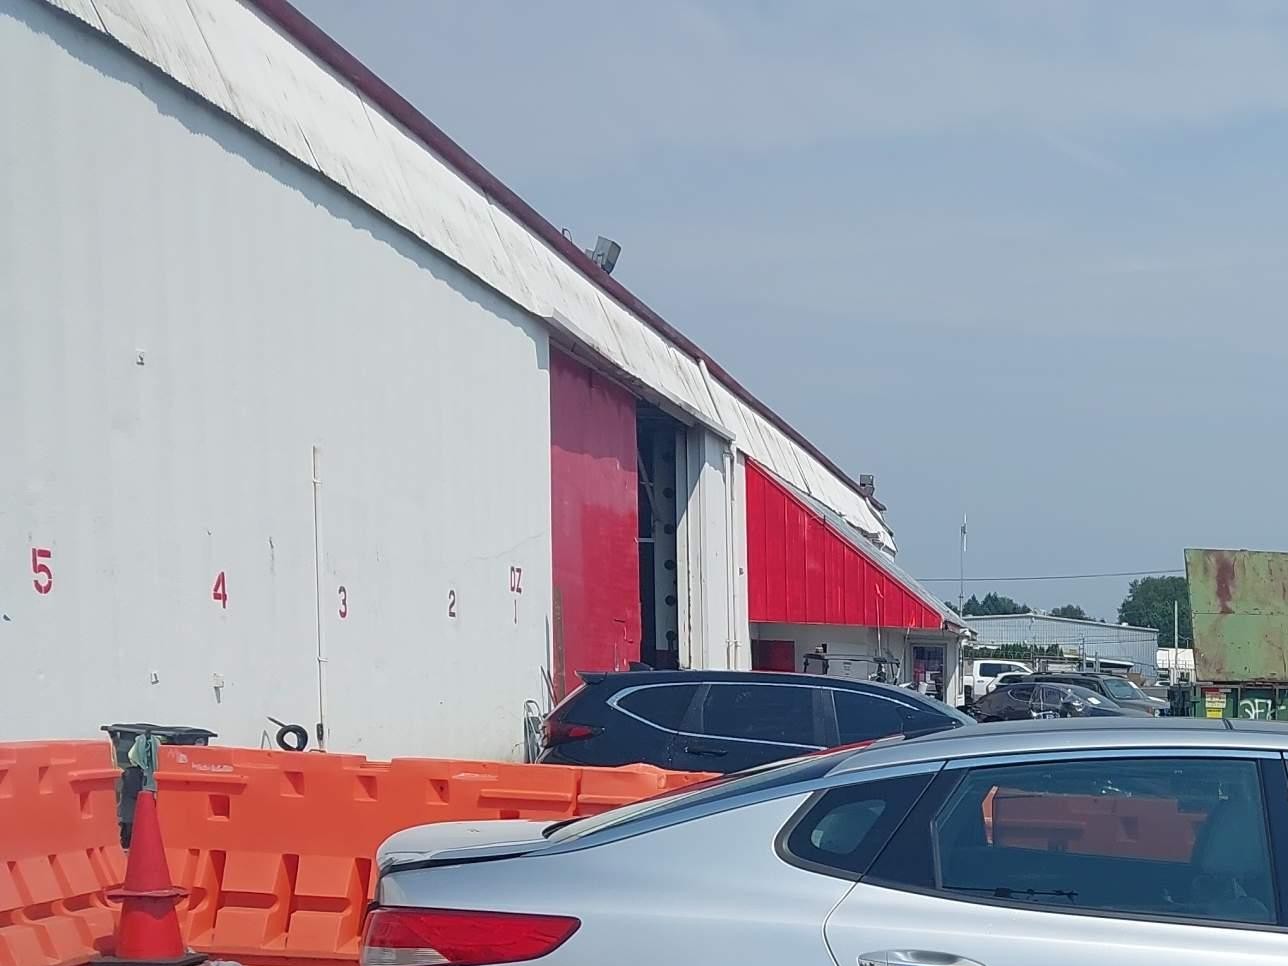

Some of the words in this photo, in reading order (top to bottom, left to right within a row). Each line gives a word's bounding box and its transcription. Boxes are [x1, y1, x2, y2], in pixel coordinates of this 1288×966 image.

[31, 547, 53, 594] 5
[212, 571, 228, 609] 4
[338, 585, 348, 619] 3
[448, 589, 456, 618] 2
